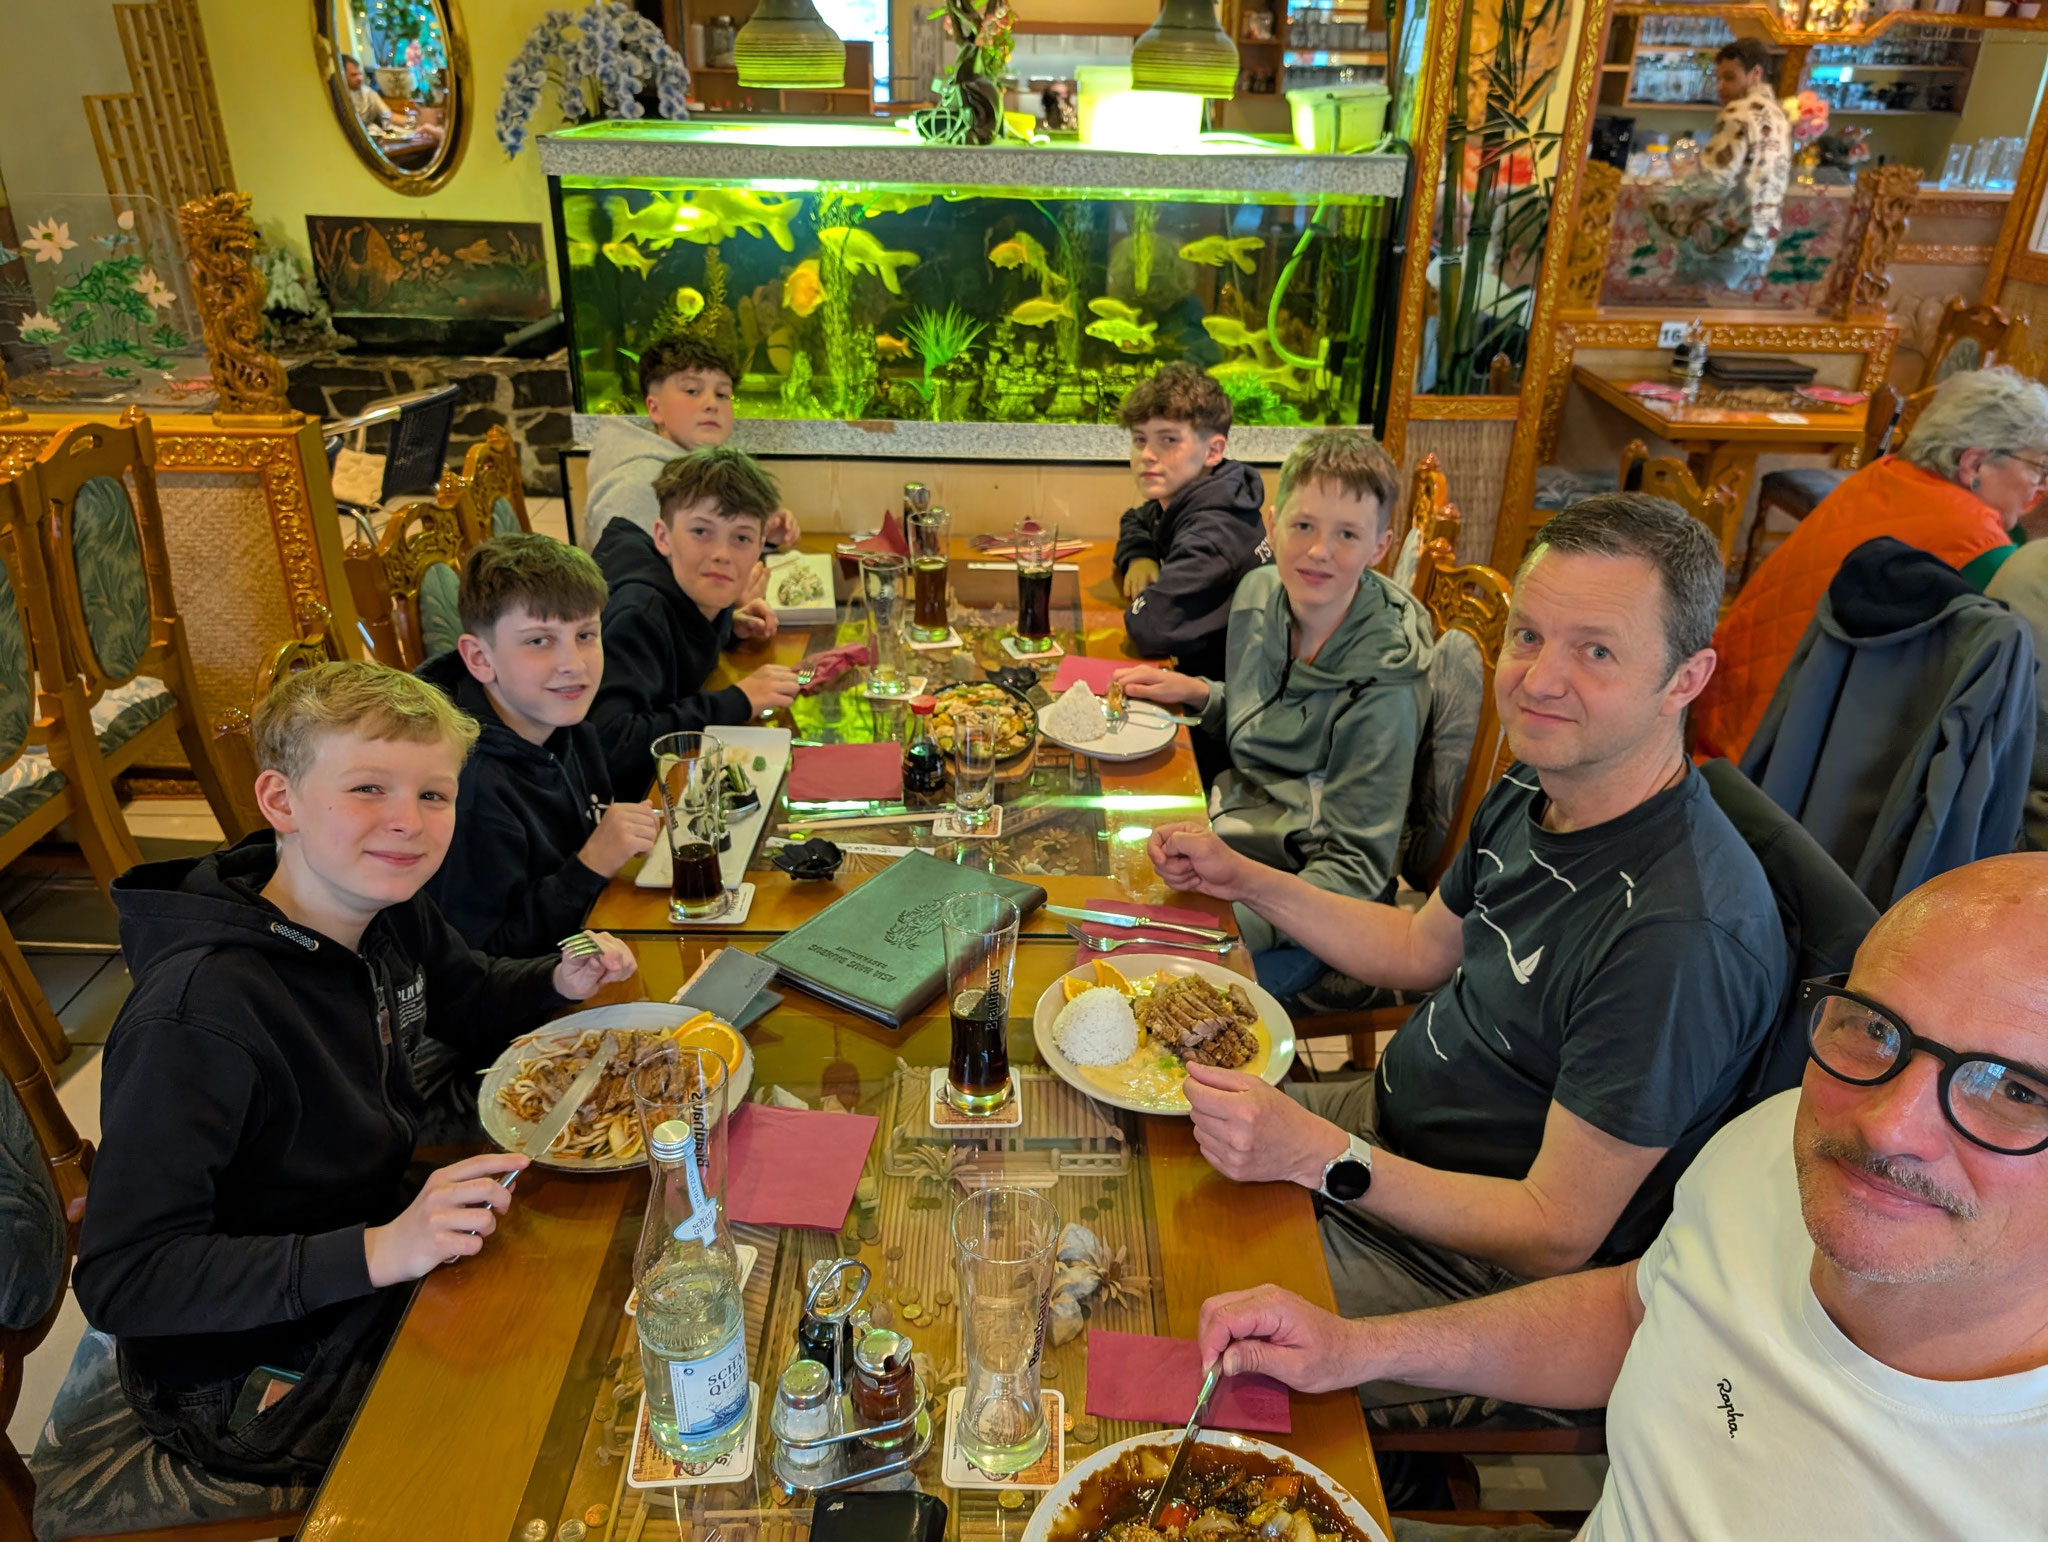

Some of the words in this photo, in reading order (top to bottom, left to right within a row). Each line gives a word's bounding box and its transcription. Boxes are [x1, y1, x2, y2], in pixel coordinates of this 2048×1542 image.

[1663, 329, 1682, 342] 16
[873, 970, 897, 983] ASIA
[985, 968, 1001, 1031] Brauhaus
[688, 1170, 704, 1209] SPRITZIG
[1028, 1287, 1050, 1369] Brauhaus
